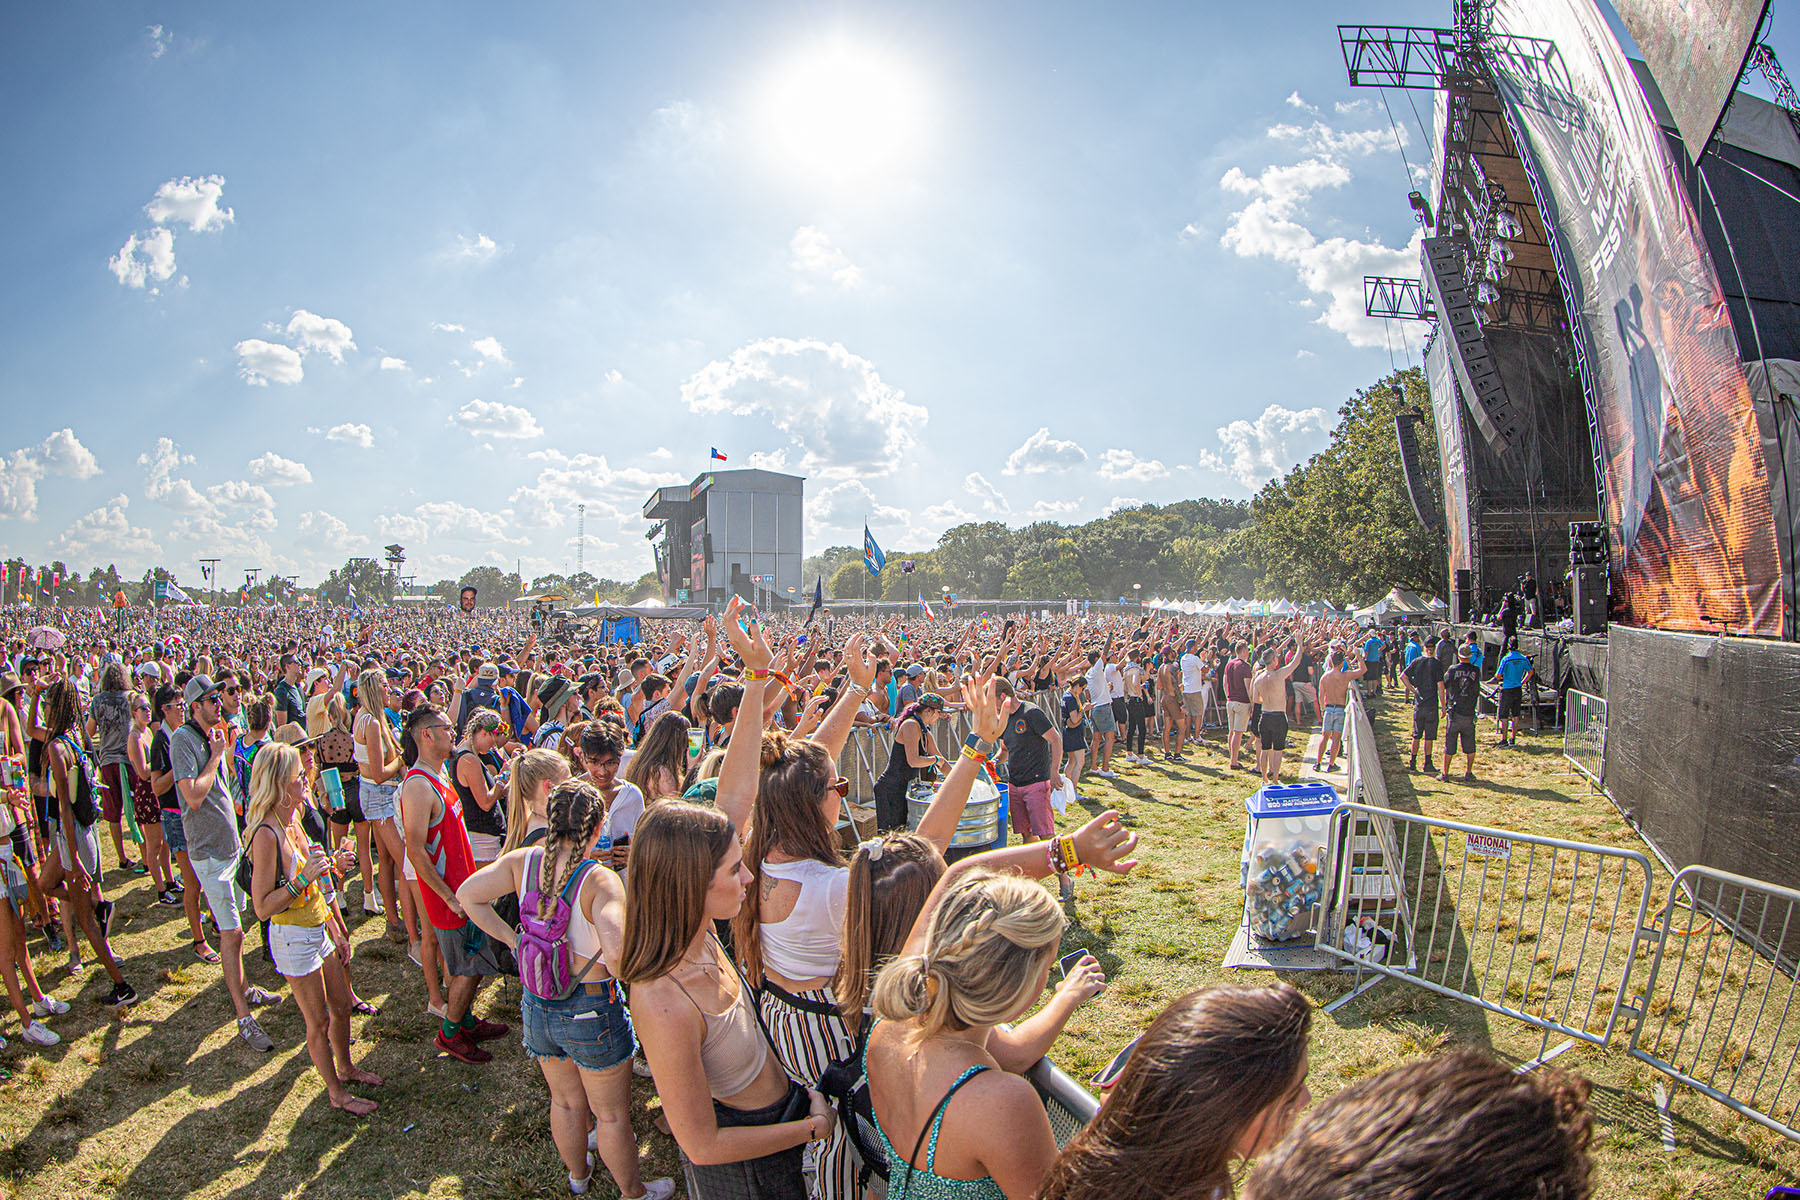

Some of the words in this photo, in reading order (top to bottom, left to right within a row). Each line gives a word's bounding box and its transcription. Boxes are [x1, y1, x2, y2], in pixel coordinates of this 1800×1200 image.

[1589, 145, 1634, 285] FESTIVA
[1591, 132, 1623, 237] MUSIC
[1467, 833, 1509, 850] NATIONAL
